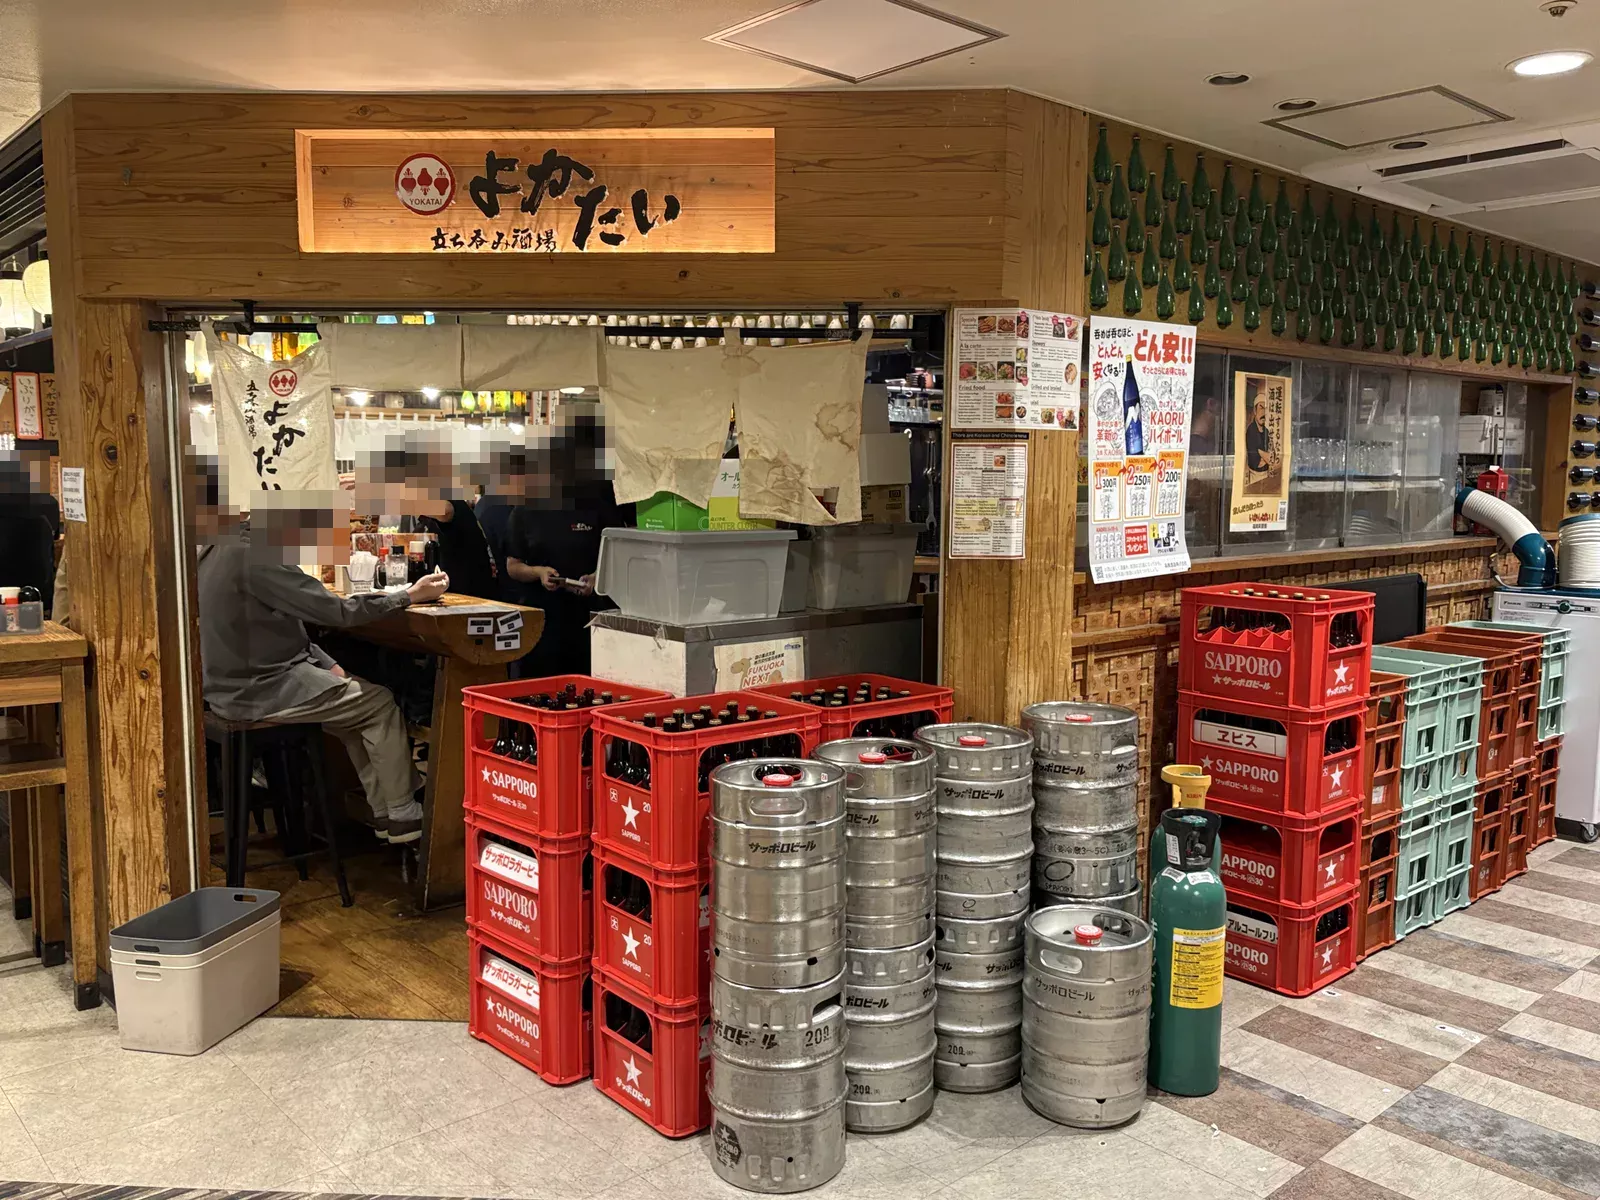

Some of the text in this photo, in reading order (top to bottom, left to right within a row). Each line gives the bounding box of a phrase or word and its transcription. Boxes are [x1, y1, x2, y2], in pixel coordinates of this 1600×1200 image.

[409, 198, 442, 208] YOKATAI
[469, 148, 680, 251] よかたい
[1150, 411, 1185, 425] KAORU
[1149, 426, 1183, 443] ハイボール
[748, 660, 785, 675] FUKUOKA
[1204, 651, 1282, 678] SAPPORO
[742, 672, 770, 687] NEXT
[1222, 676, 1271, 691] サッポロビール
[1326, 683, 1353, 697] サッポロビール
[1033, 759, 1086, 776] サッポロビール
[1216, 758, 1279, 783] SAPPORO
[491, 769, 537, 799] SAPPORO
[1214, 777, 1249, 790] サッポロビール
[944, 787, 1004, 800] サッポロビール
[1328, 789, 1343, 798] SAPPORO
[621, 829, 641, 842] SAPPORO
[748, 839, 816, 854] サッポロビール
[484, 880, 538, 922] SAPPORO
[497, 911, 531, 934] サッポロビール
[643, 933, 653, 946] 20
[621, 956, 642, 973] SAPPORO
[1035, 977, 1096, 1001] サッポロビール
[496, 1003, 540, 1040] SAPPORO
[616, 1076, 652, 1107] サッポロビール
